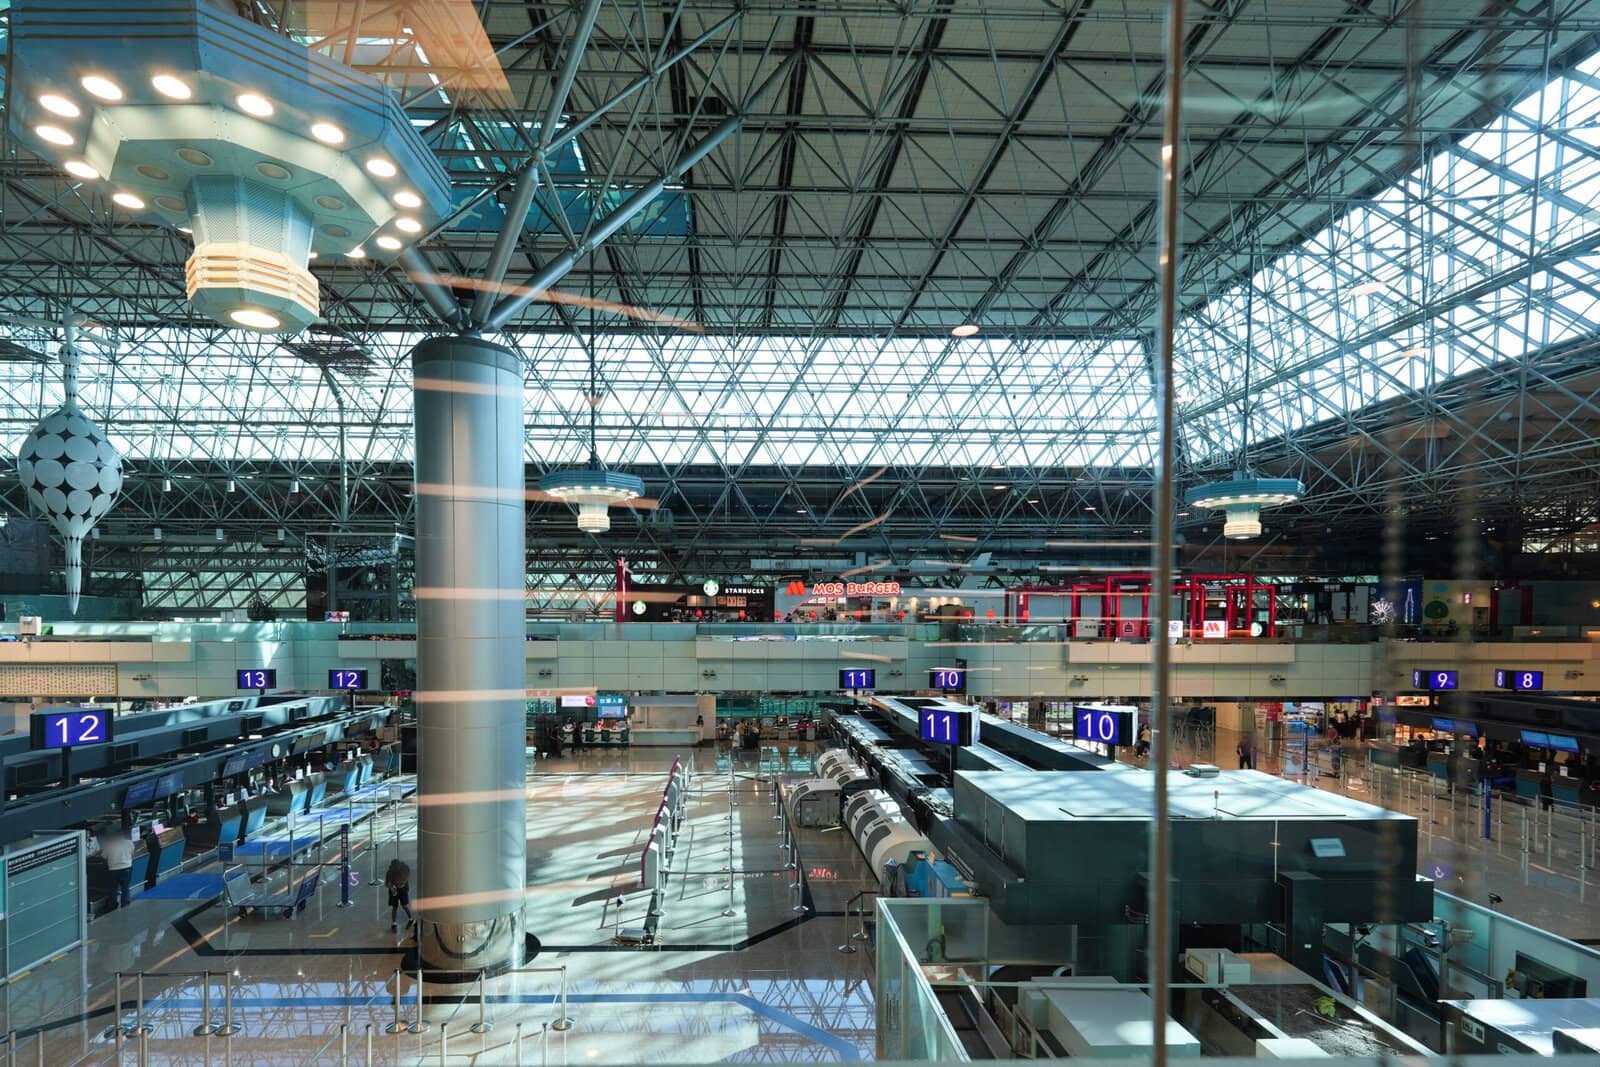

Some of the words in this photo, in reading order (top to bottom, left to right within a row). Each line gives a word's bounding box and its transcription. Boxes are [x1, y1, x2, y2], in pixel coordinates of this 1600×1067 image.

[724, 587, 765, 595] STARBUCKS
[812, 583, 844, 596] MOS
[847, 582, 899, 595] BURGER
[244, 671, 266, 688] 13
[336, 671, 359, 688] 12
[847, 671, 867, 687] 11
[938, 671, 959, 687] 10
[1437, 672, 1448, 688] 9
[1522, 672, 1533, 689] 8
[55, 714, 100, 745] 12
[926, 713, 952, 741] 11
[1082, 712, 1115, 741] 10
